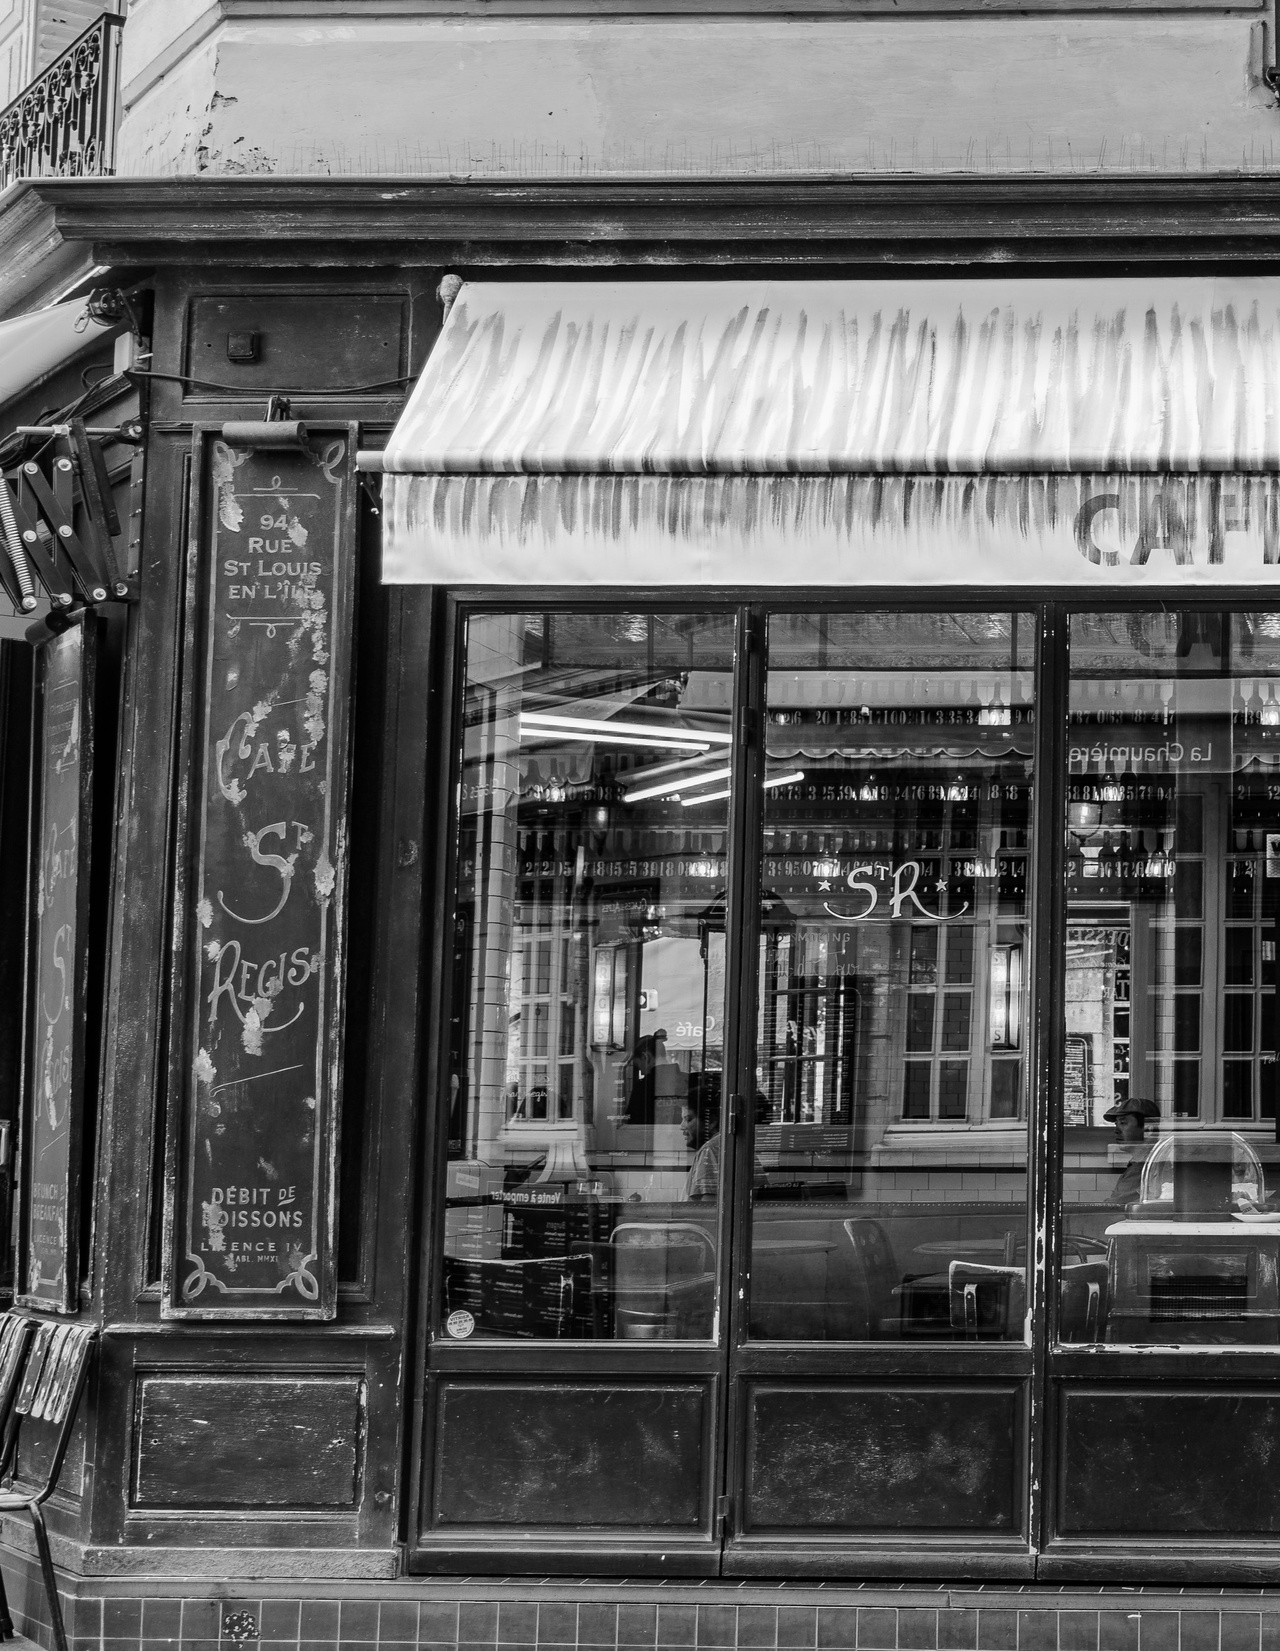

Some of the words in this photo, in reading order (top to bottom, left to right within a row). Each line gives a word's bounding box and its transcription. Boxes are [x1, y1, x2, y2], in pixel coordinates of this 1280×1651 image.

[260, 514, 288, 531] 94
[248, 537, 293, 554] RUE
[257, 560, 322, 577] LOUIS
[228, 584, 256, 600] EN
[211, 1185, 271, 1205] DÉBIT
[279, 1186, 296, 1200] DE
